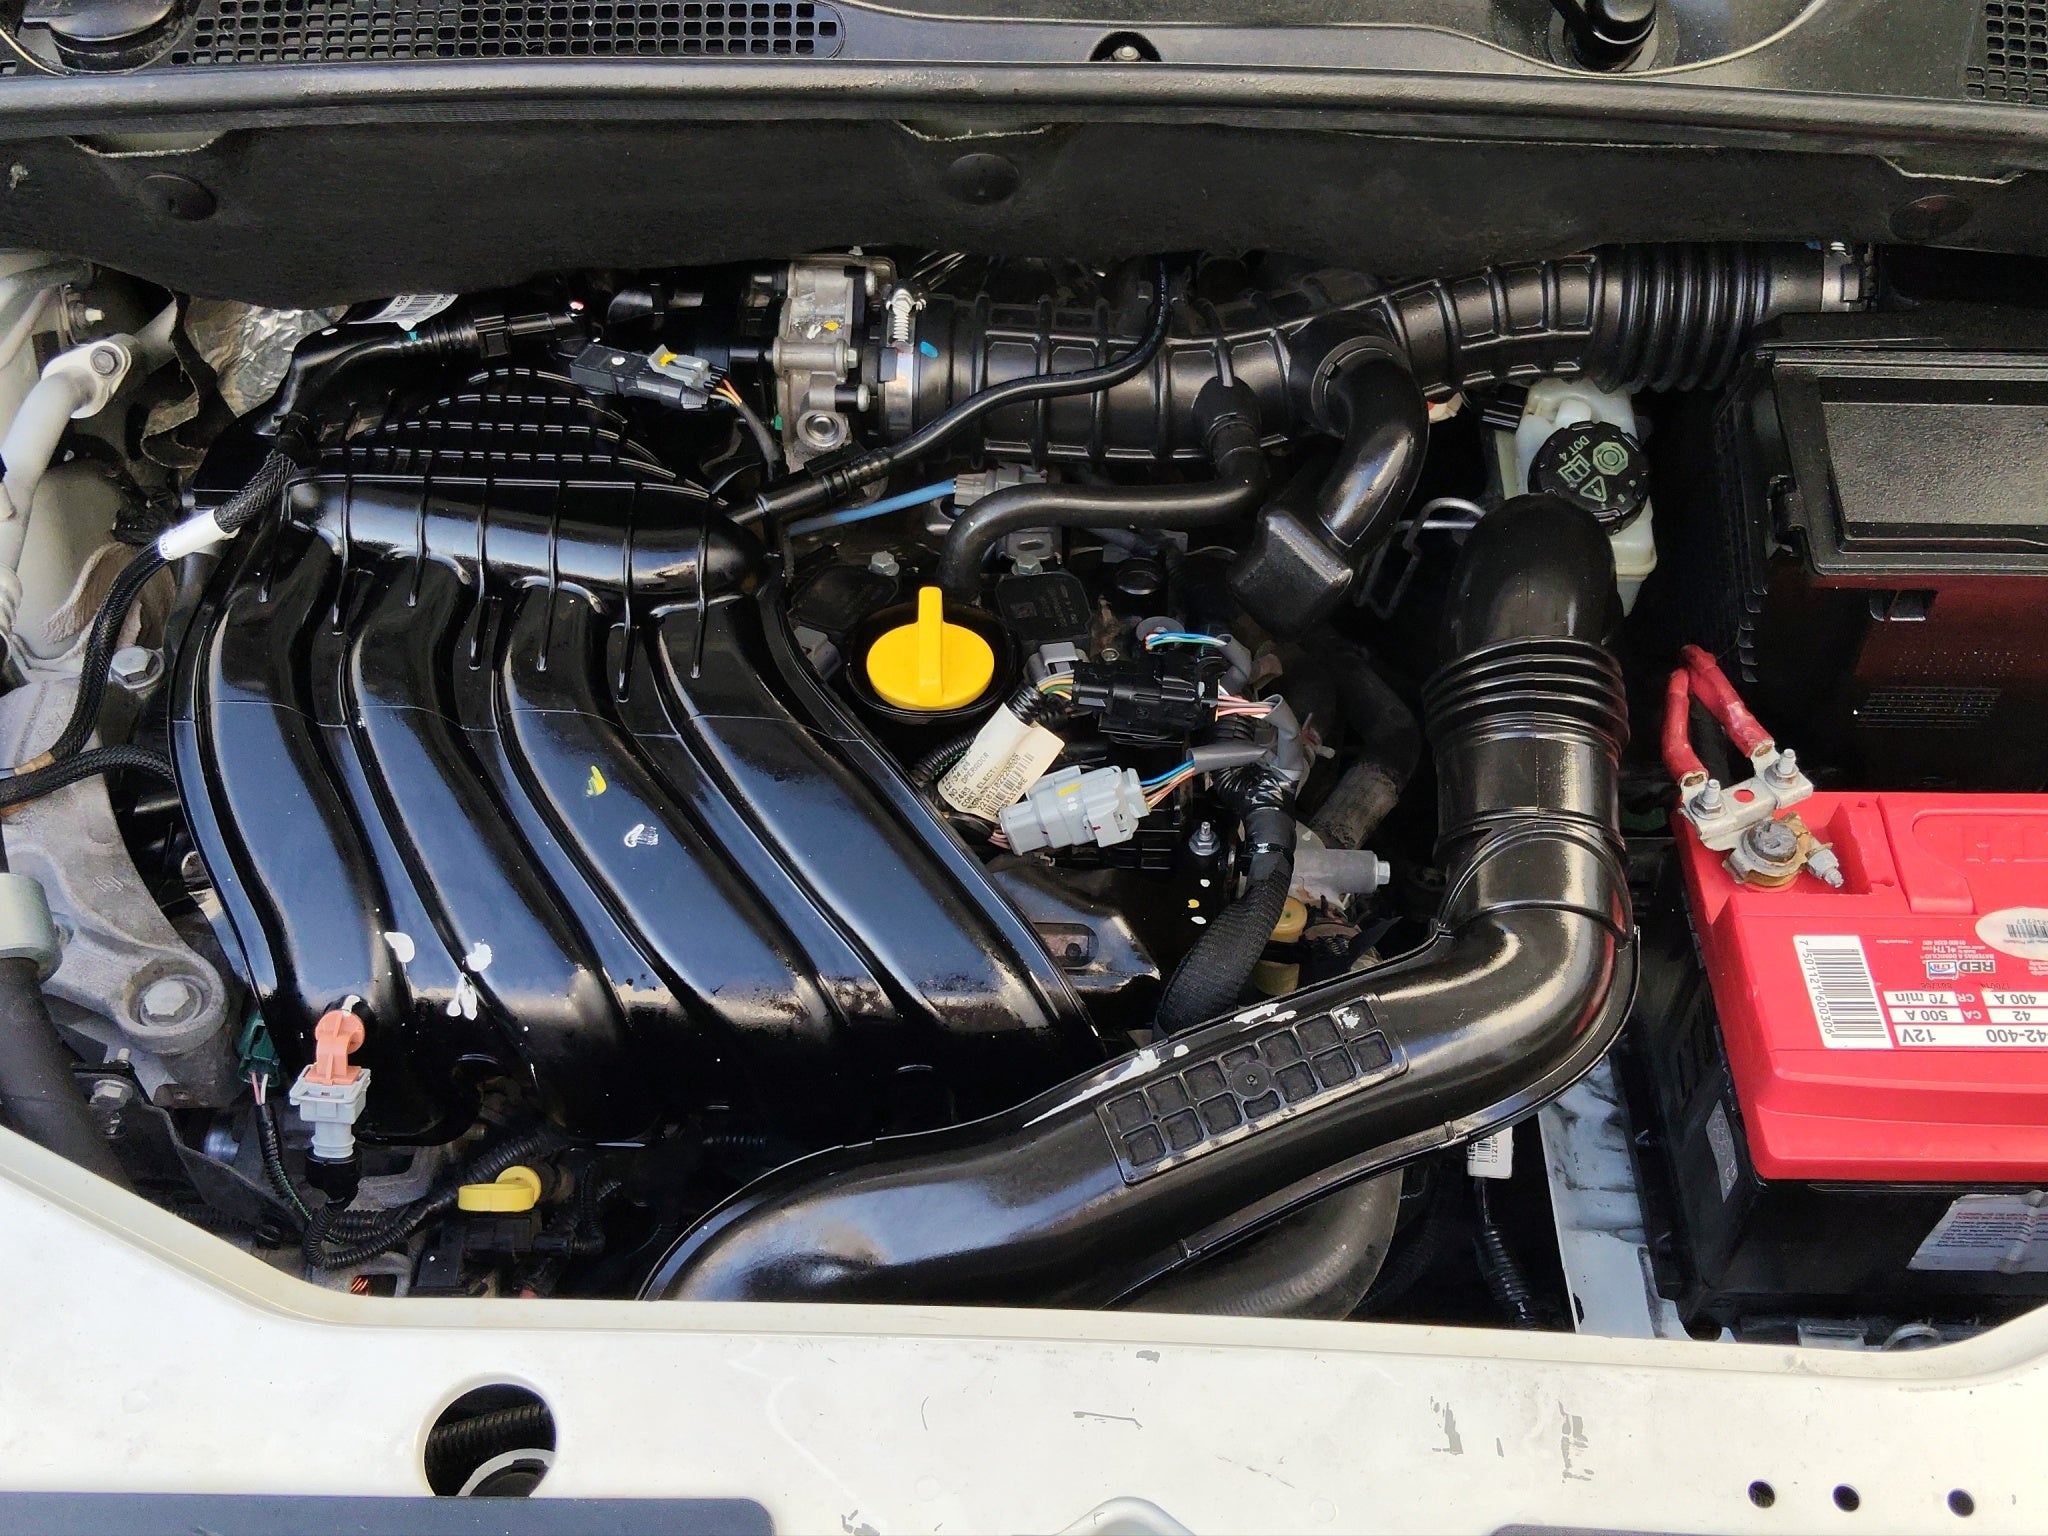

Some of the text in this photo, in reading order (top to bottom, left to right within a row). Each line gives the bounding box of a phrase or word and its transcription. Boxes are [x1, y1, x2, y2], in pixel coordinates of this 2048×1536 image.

[1558, 435, 1590, 462] DOT 4
[1959, 961, 1994, 973] RED
[1802, 953, 1820, 991] 501121
[1815, 996, 1834, 1035] 600306
[1895, 992, 1949, 1004] 70 min
[1956, 993, 1975, 1003] CR
[1994, 994, 2037, 1005] 400 A
[1904, 1010, 1949, 1021] 500 A
[1962, 1010, 1982, 1019] CA
[2012, 1010, 2031, 1021] 42
[1902, 1028, 1937, 1043] 12V
